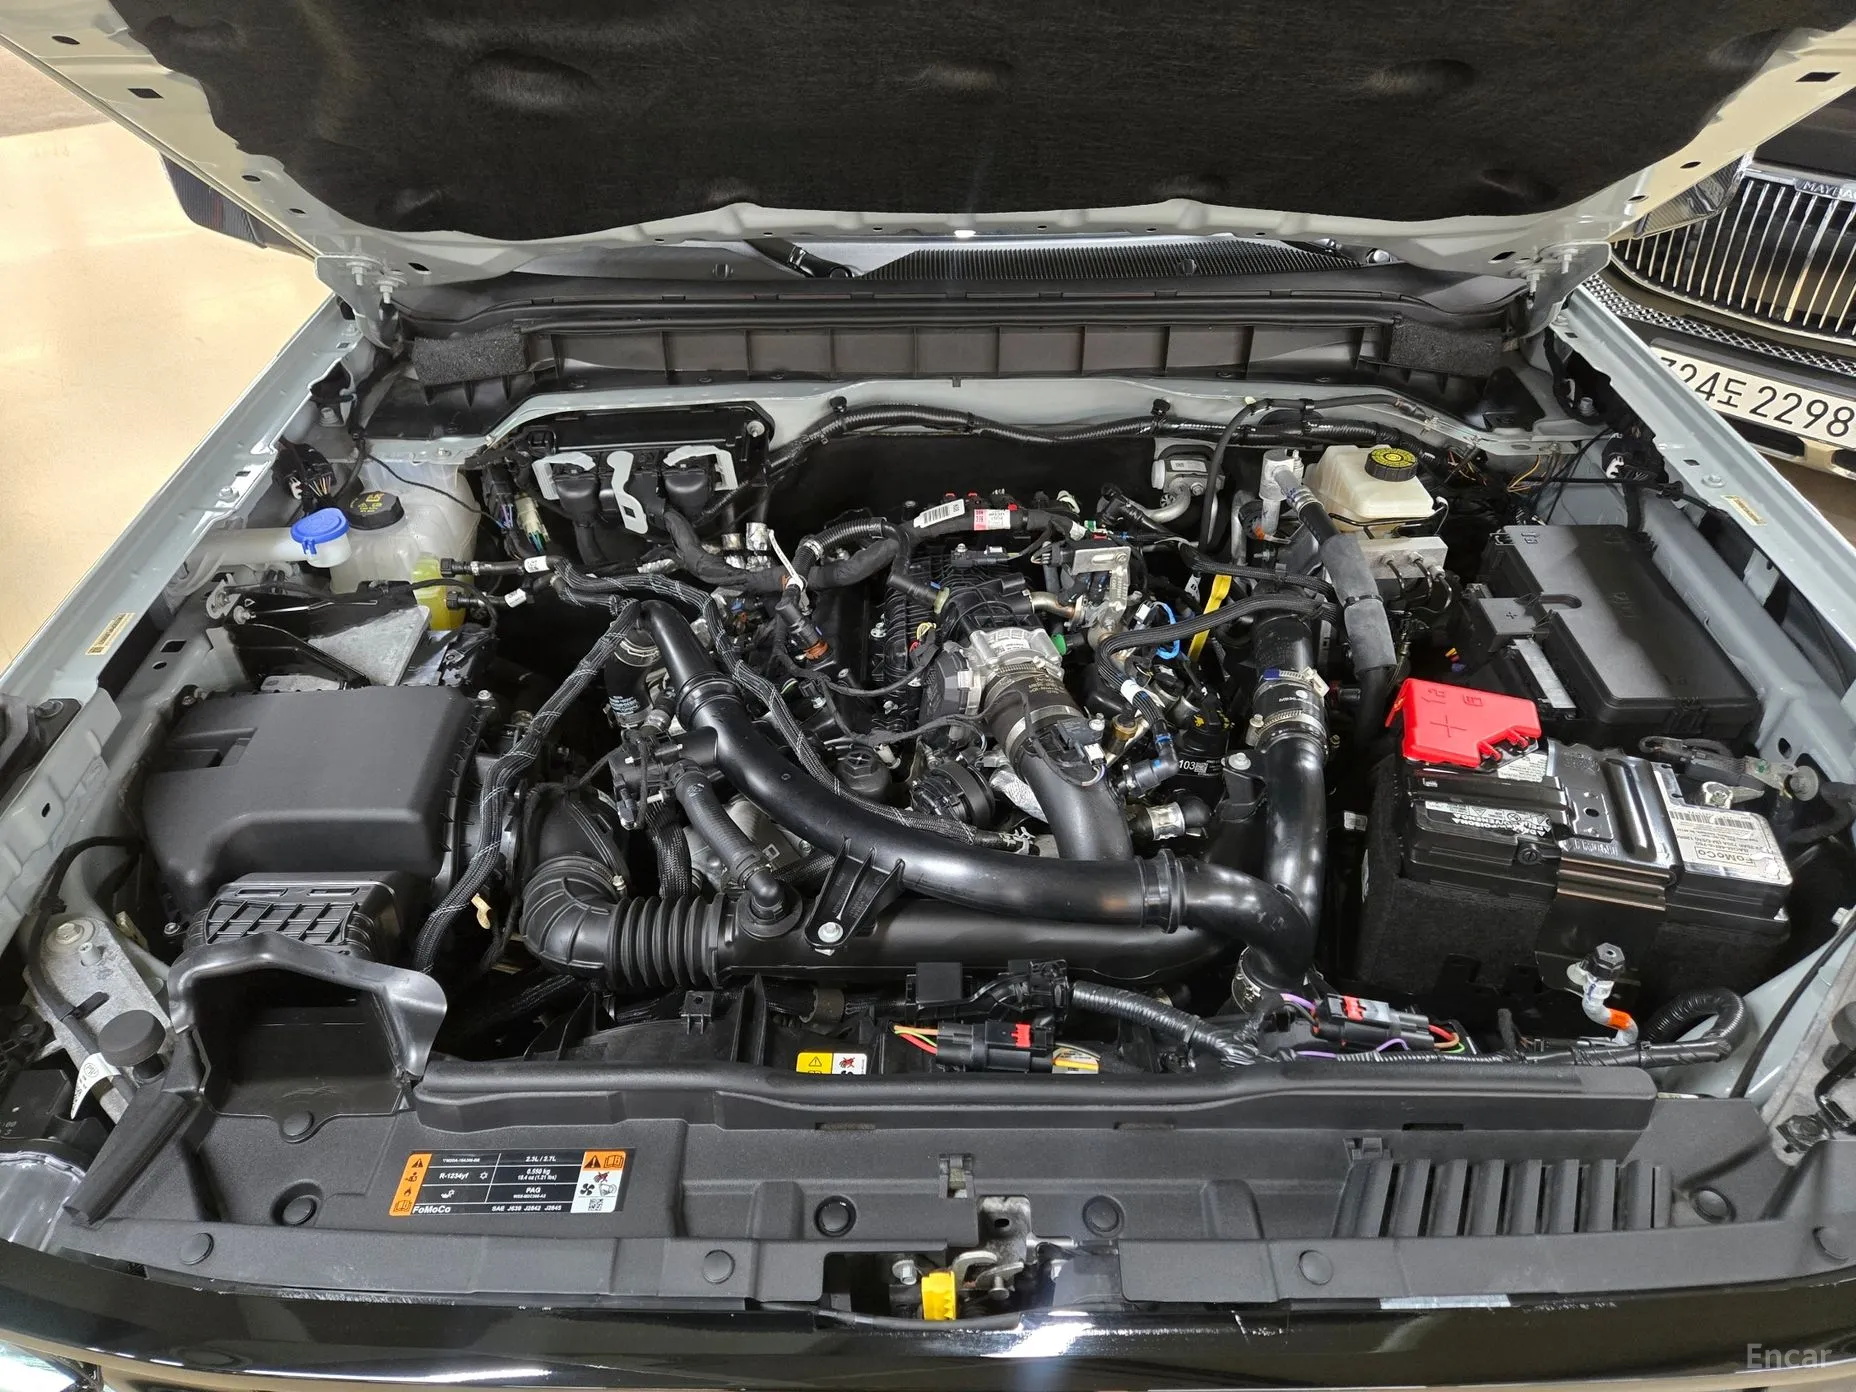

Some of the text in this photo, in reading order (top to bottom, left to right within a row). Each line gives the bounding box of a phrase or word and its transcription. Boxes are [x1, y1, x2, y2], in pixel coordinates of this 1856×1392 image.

[1749, 385, 1855, 438] 2298
[438, 1172, 470, 1180] R-1234yf
[412, 1205, 452, 1214] FoMoCo
